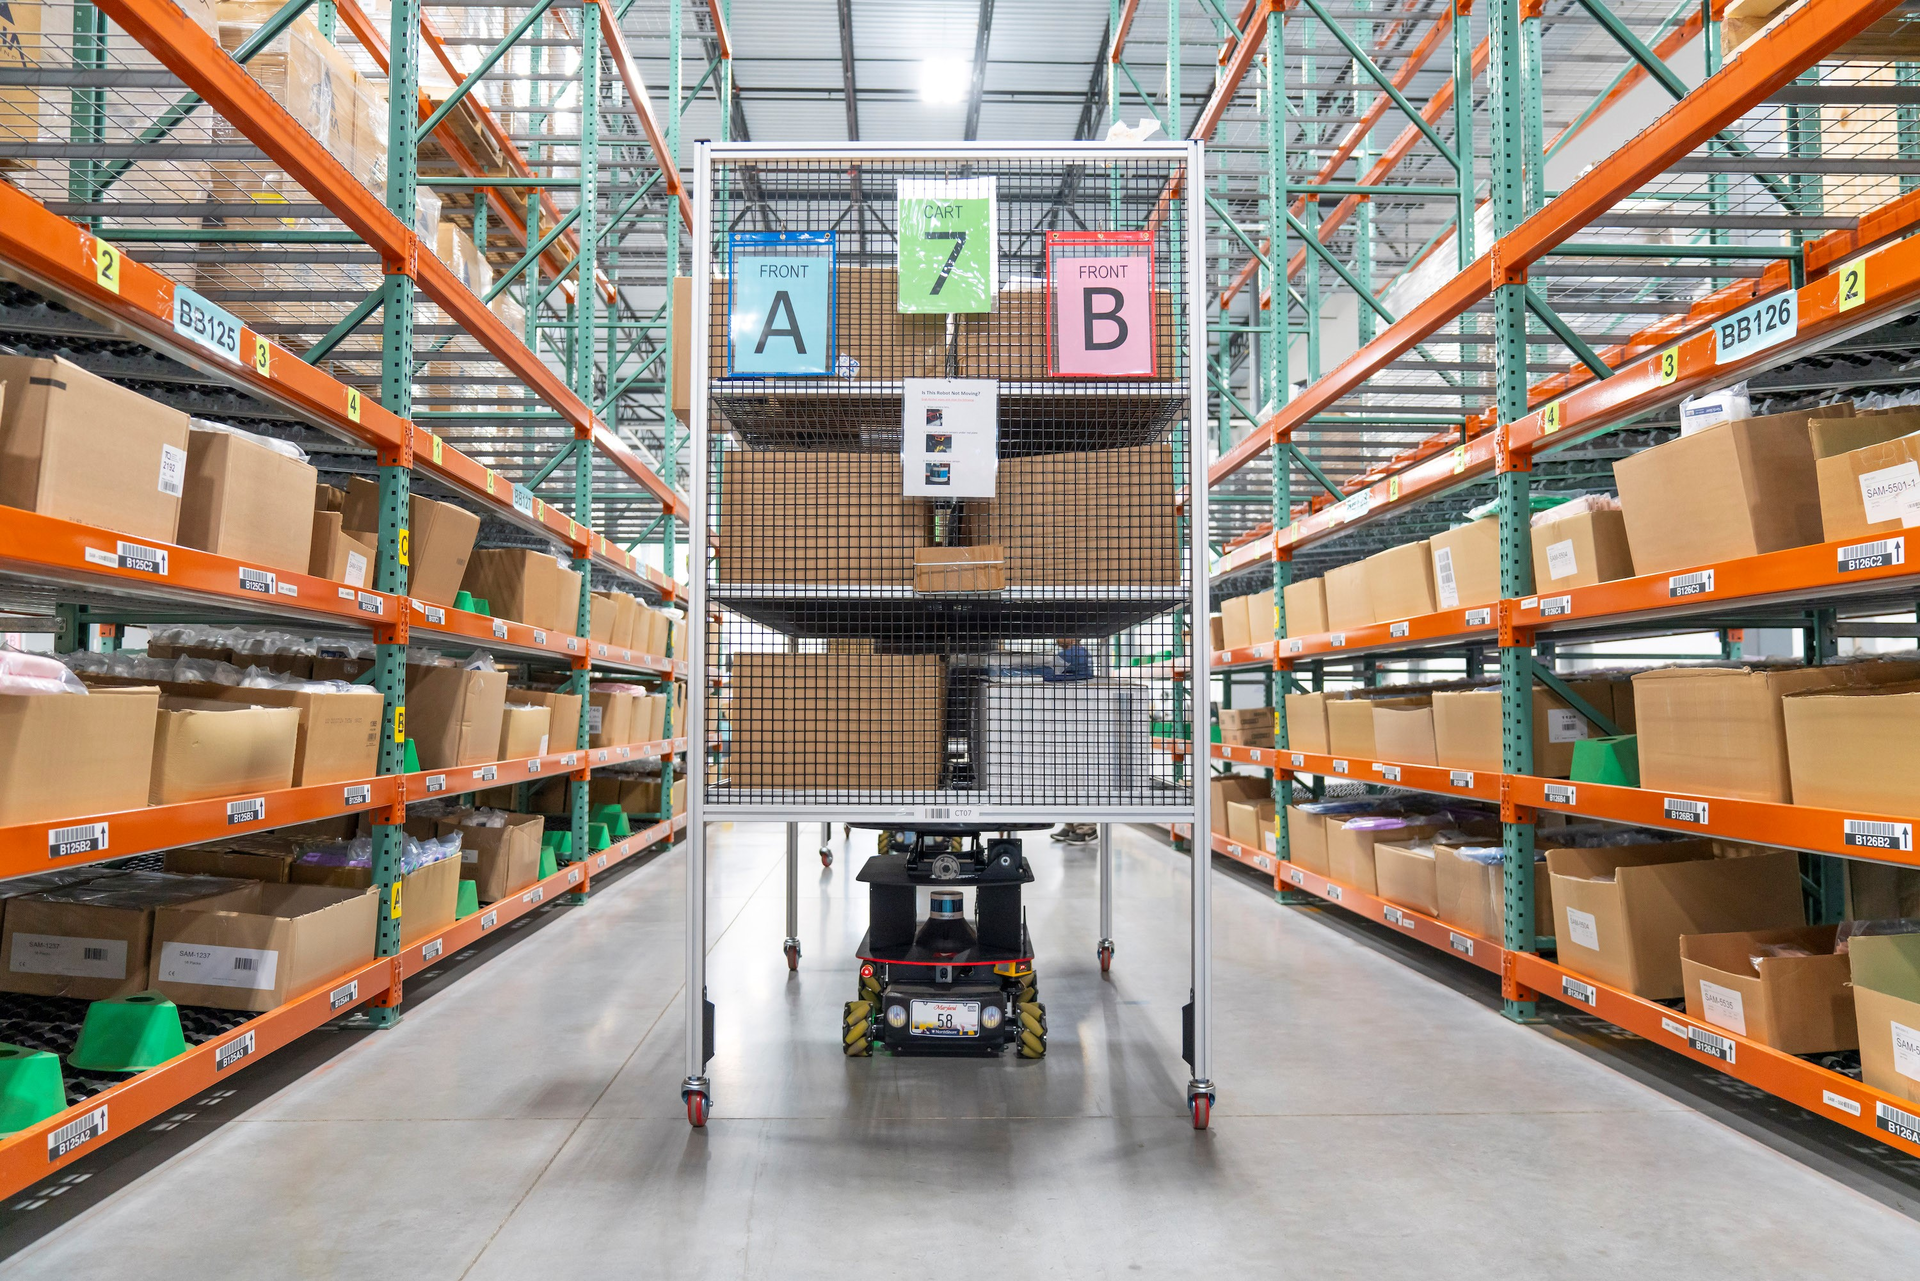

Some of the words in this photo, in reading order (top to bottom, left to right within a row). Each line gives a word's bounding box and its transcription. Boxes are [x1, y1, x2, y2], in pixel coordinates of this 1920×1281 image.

[924, 205, 962, 219] CART
[102, 250, 113, 280] 2
[760, 264, 808, 278] FRONT
[925, 232, 966, 296] 7
[1080, 264, 1128, 278] FRONT
[1845, 271, 1858, 301] 2
[180, 298, 236, 352] BB125
[754, 291, 807, 354] A
[1084, 288, 1128, 351] B
[1721, 298, 1790, 350] BB126
[258, 344, 267, 367] 3
[1665, 354, 1674, 378] 3
[350, 395, 357, 416] 4
[1548, 408, 1554, 426] 4
[436, 441, 440, 458] 1
[488, 473, 493, 490] 2
[1392, 481, 1396, 496] 2
[1866, 478, 1916, 498] SAM-5501-1
[514, 488, 532, 510] BB127
[402, 537, 407, 556] C
[127, 558, 153, 572] B125C2
[1848, 556, 1882, 570] B126C2
[246, 580, 265, 592] B125C3
[1676, 584, 1700, 596] B126C3
[398, 712, 404, 733] B
[234, 812, 254, 824] B125B3
[1671, 809, 1694, 822] B126B3
[60, 840, 91, 855] B125B2
[1856, 834, 1890, 848] B126B2
[394, 888, 400, 910] A
[180, 950, 211, 958] SAM-1237
[1567, 988, 1585, 1001] B126A4
[1705, 993, 1733, 1010] SAM-5535
[938, 1014, 952, 1028] 58
[1696, 1041, 1720, 1057] B126A3
[222, 1049, 244, 1068] B125A3
[1888, 1121, 1920, 1144] B126A
[59, 1130, 91, 1155] B125A2
